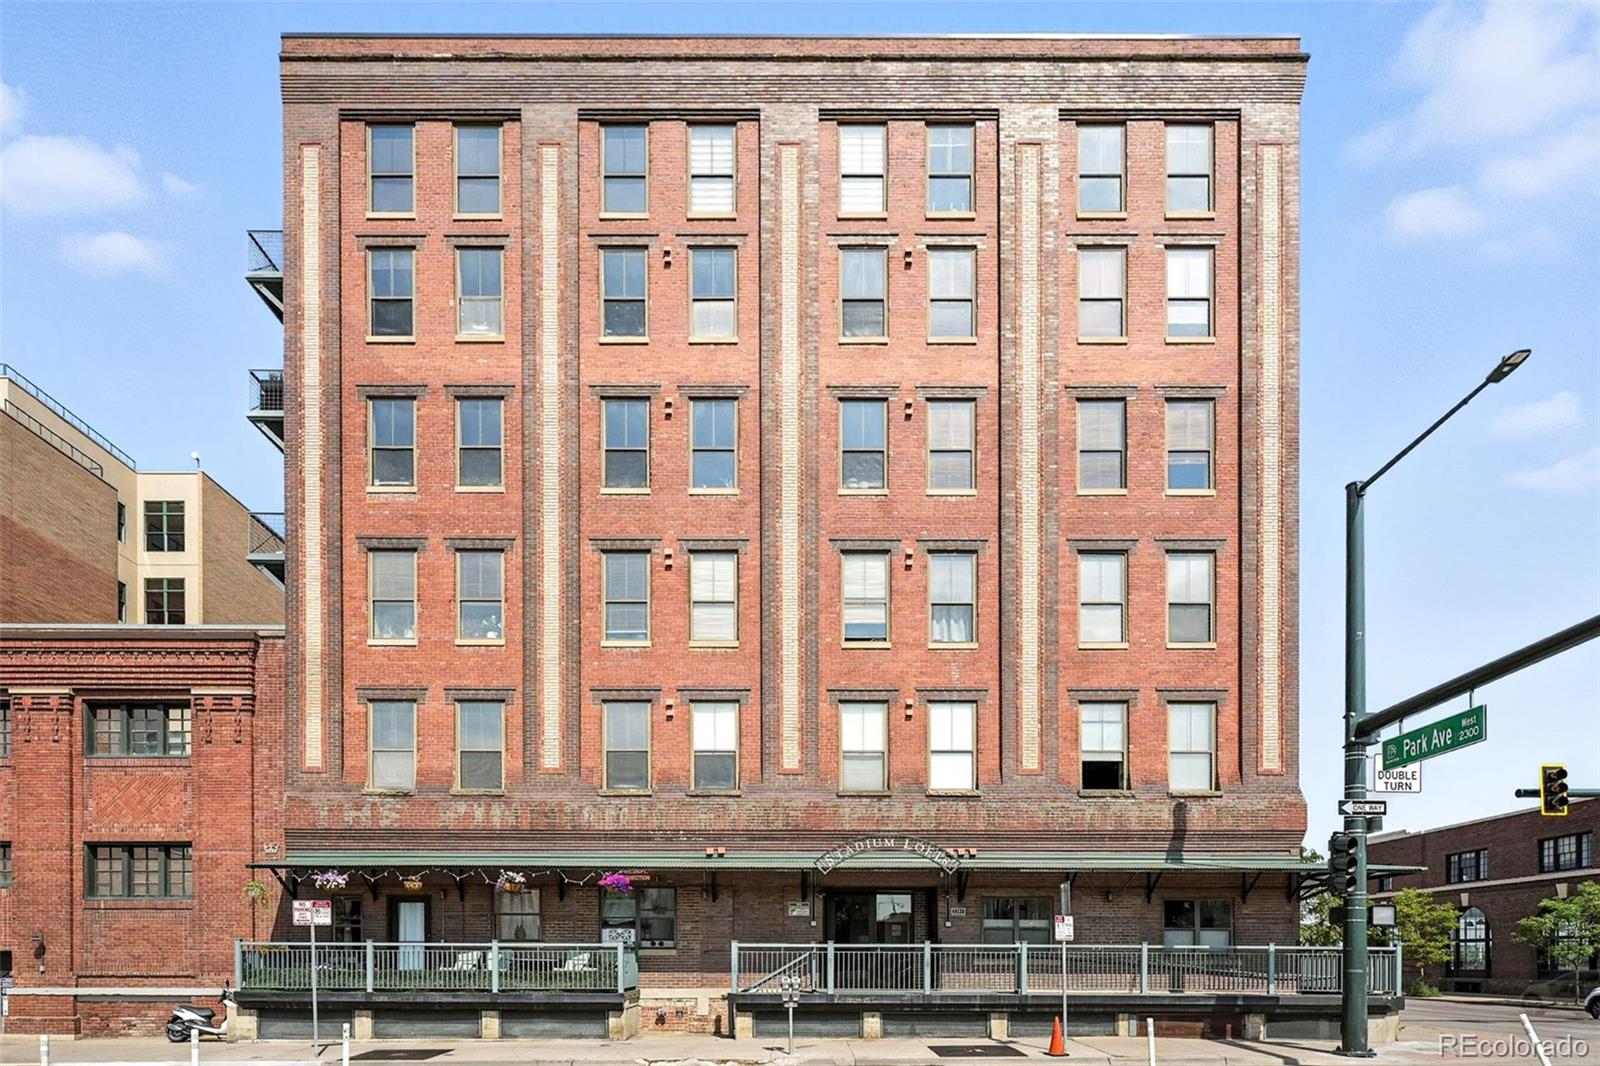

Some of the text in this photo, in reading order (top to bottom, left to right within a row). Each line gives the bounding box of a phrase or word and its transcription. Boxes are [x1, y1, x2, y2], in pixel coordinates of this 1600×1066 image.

[1461, 715, 1477, 727] West
[1459, 725, 1479, 741] 2300
[1403, 728, 1452, 759] Park Ave
[1377, 770, 1417, 780] DOUBLE
[1384, 781, 1412, 791] TURN
[824, 838, 950, 867] STADIUM LOFTS
